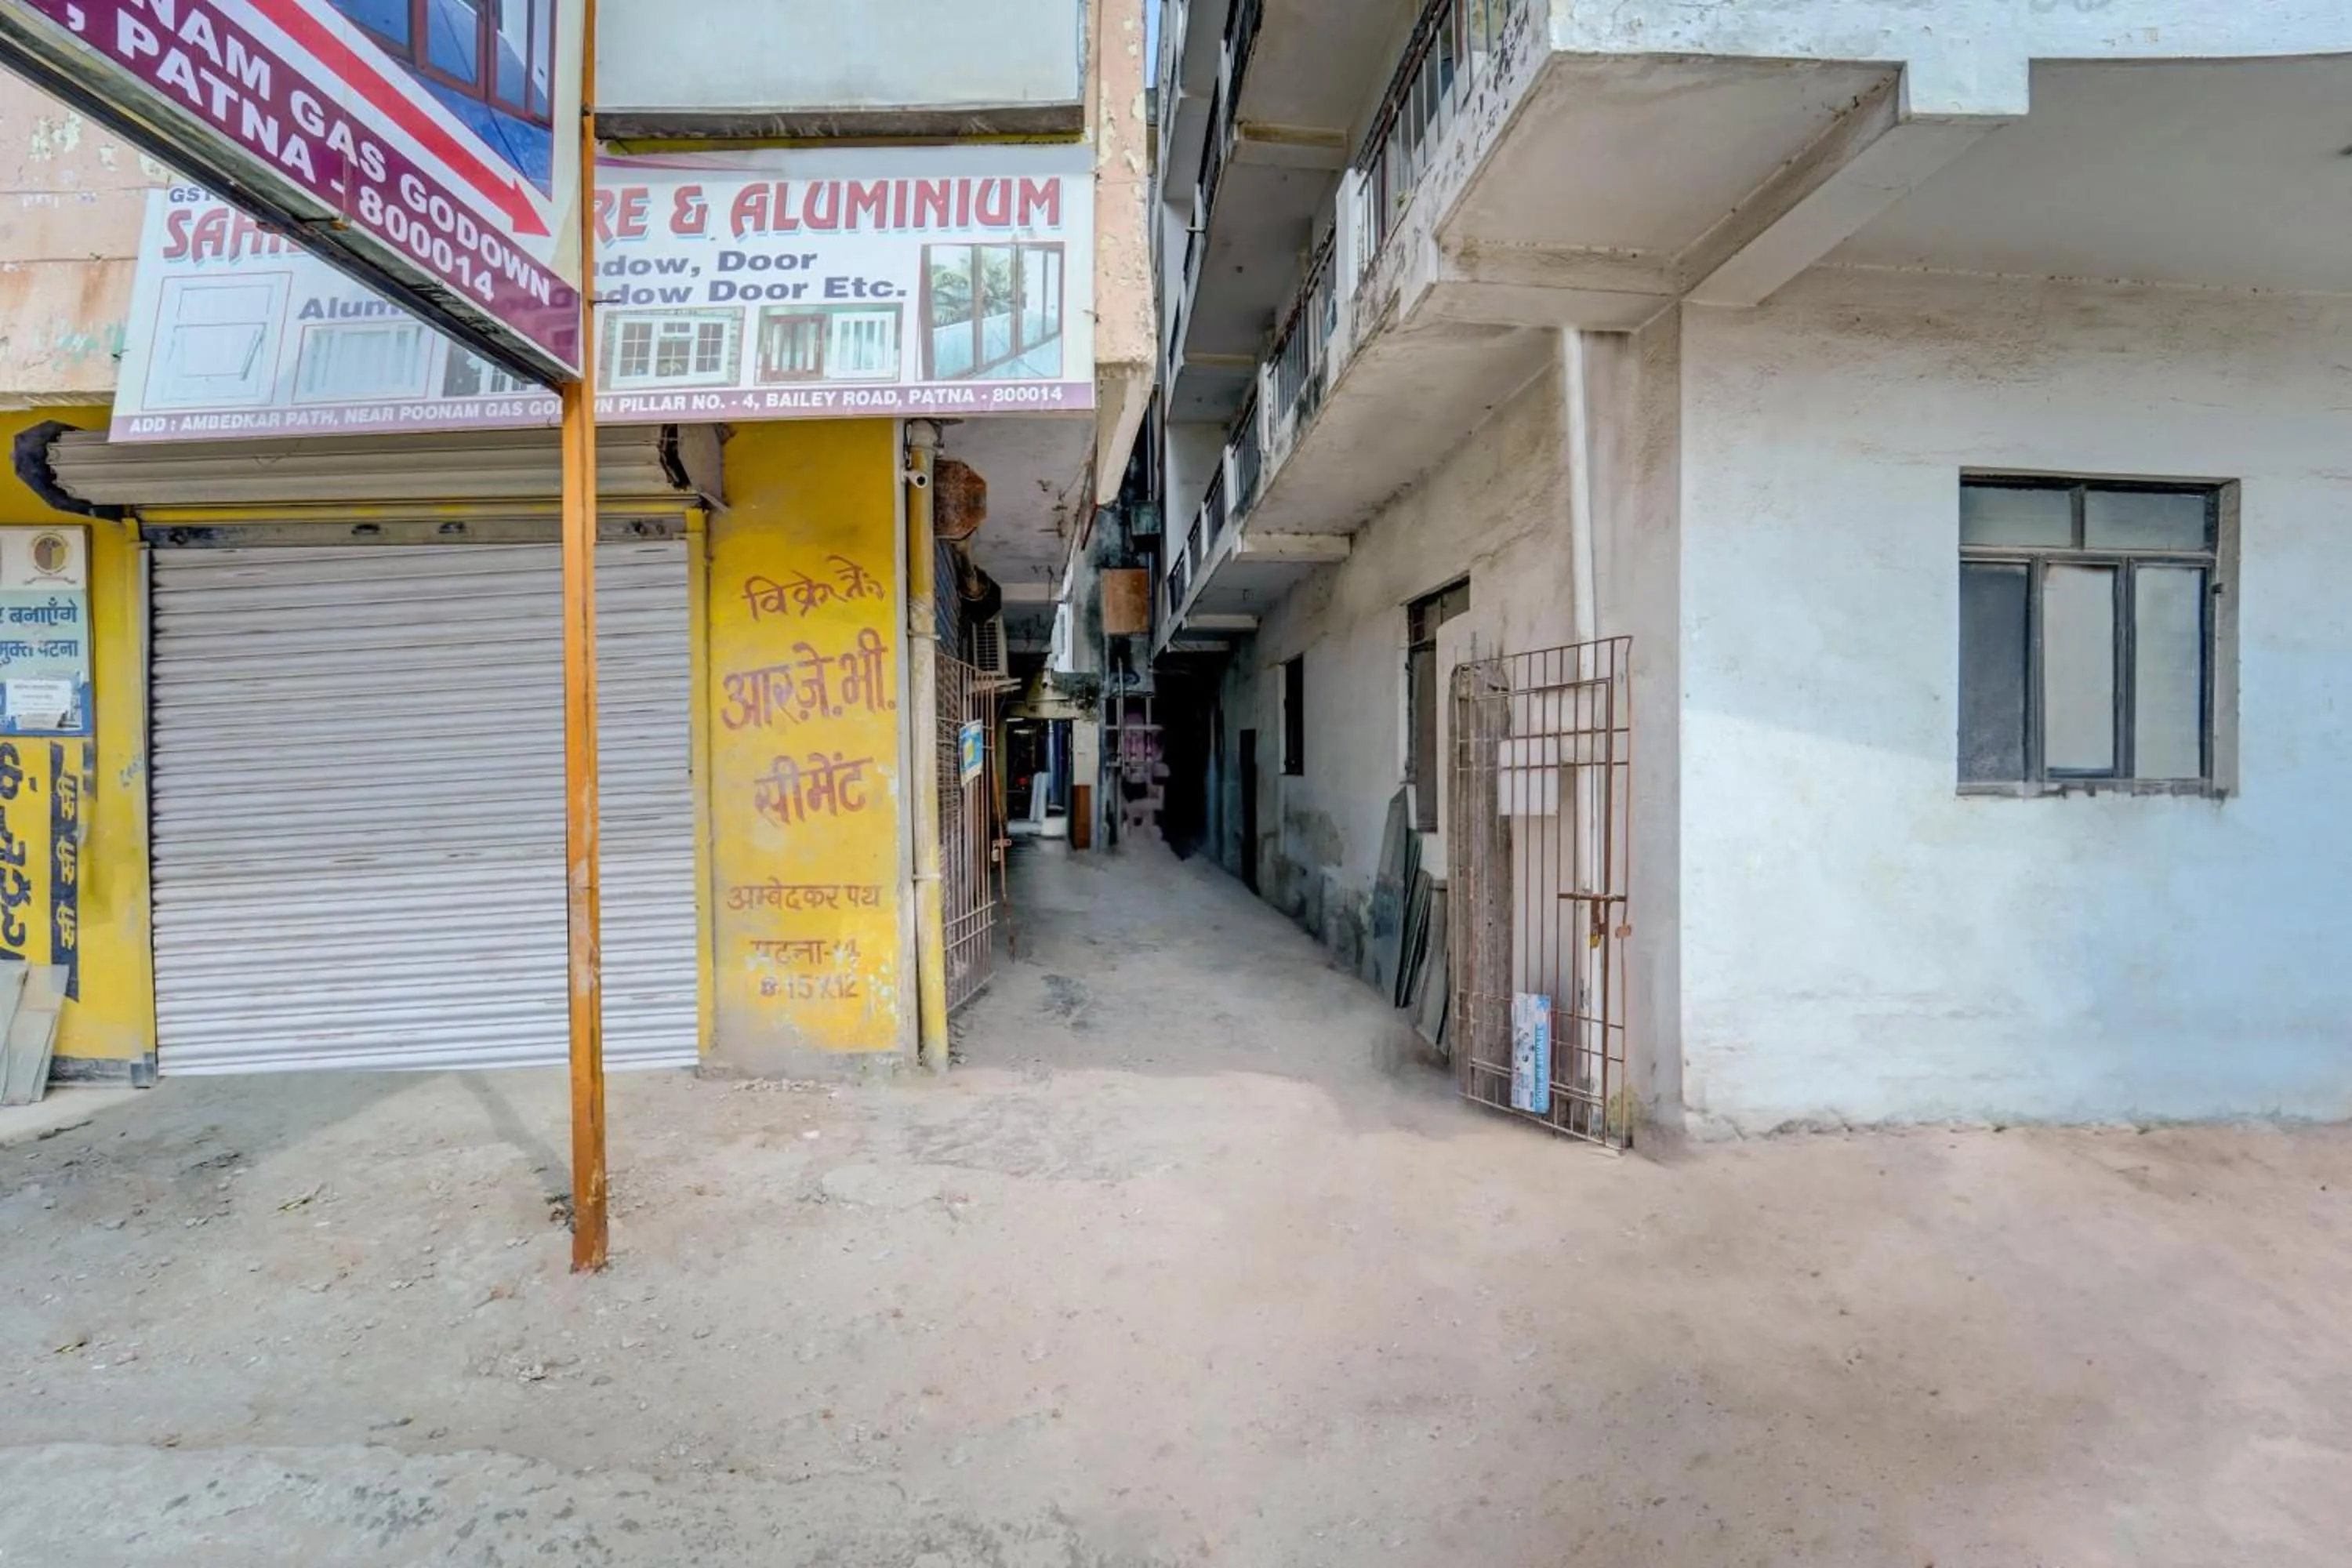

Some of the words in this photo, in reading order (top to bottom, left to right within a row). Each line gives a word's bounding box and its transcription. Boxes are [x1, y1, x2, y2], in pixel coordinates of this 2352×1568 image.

[117, 7, 316, 184] PATNA
[358, 185, 495, 303] 800014
[290, 89, 387, 183] GAS
[400, 172, 550, 306] GODOWN
[670, 185, 708, 234] &
[730, 177, 1061, 236] ALUMINIUM
[717, 250, 818, 273] Door
[708, 278, 808, 303] Door
[823, 276, 907, 299] Etc.
[129, 416, 166, 432] ADD
[180, 413, 281, 432] AMBEDKAR
[285, 408, 339, 426] PATH,
[344, 405, 394, 424] NEAR
[400, 402, 480, 421] POONAM
[485, 401, 523, 417] GAS
[619, 394, 687, 412] PILLAR
[691, 394, 725, 411] NO.
[742, 394, 760, 411] 4,
[765, 390, 837, 408] BAILEY
[842, 389, 902, 407] ROAD,
[908, 387, 975, 405] PATNA
[992, 386, 1064, 403] 800014
